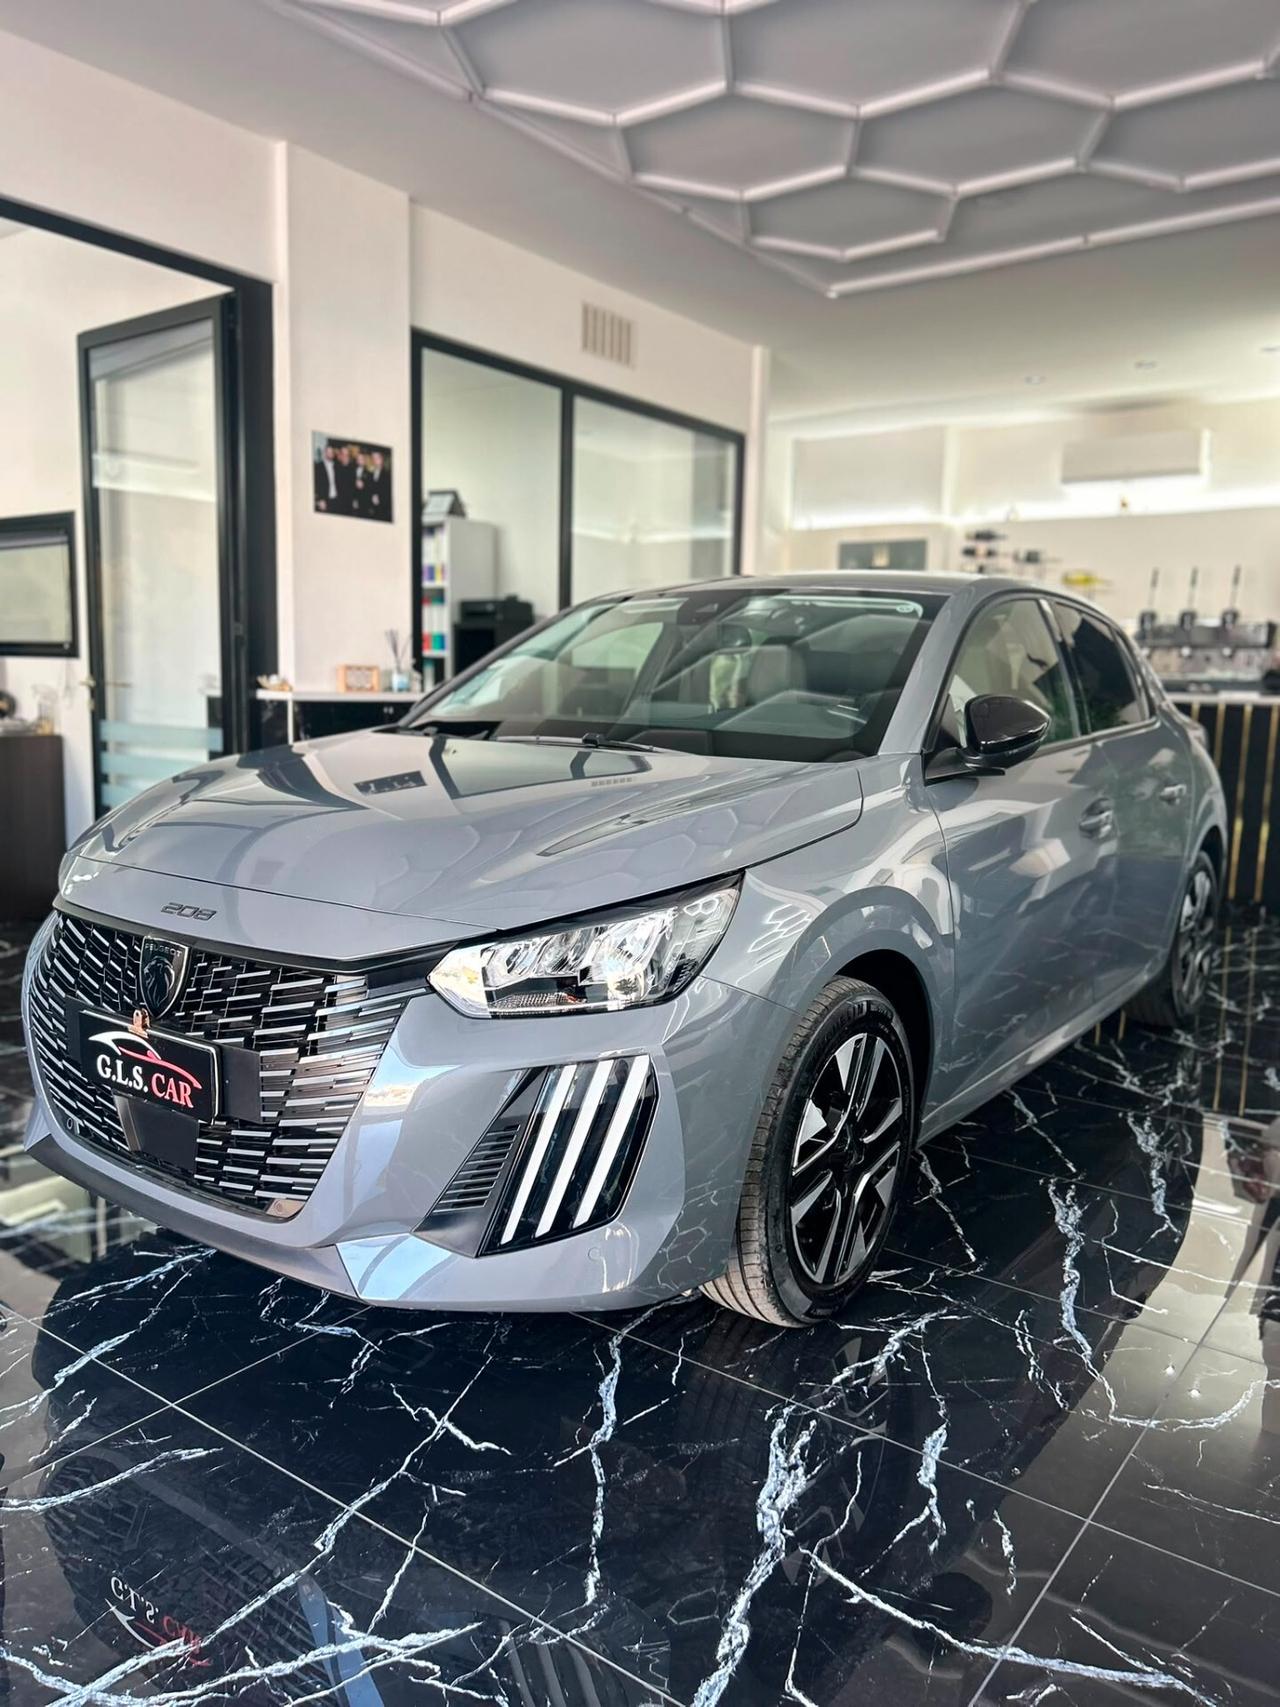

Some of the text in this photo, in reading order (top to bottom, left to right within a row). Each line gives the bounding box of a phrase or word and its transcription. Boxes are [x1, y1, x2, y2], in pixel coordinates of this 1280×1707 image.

[160, 901, 217, 921] 208
[144, 942, 183, 957] PEUGEOT
[97, 1054, 194, 1108] G.L.S. CAR
